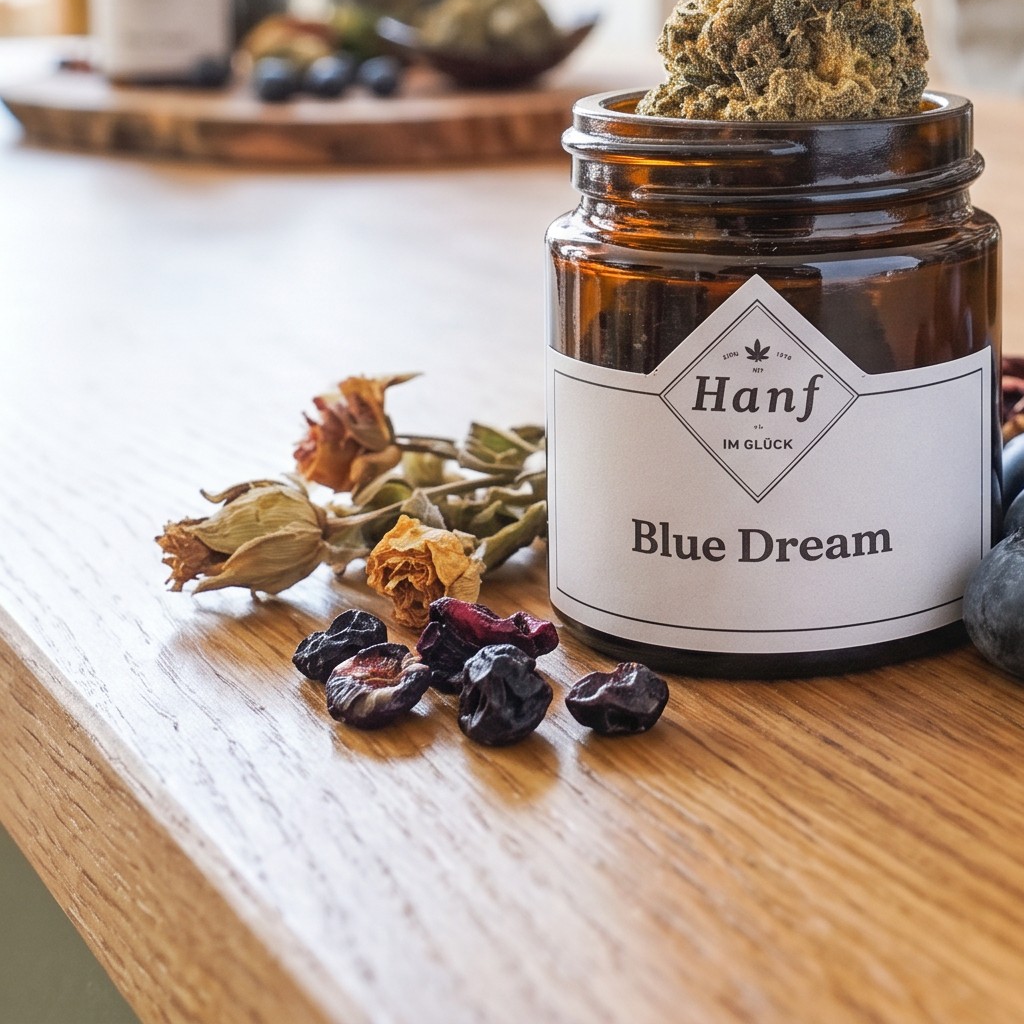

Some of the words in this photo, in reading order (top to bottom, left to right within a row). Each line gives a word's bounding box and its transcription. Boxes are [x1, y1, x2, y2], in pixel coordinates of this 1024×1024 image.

[691, 374, 824, 423] Hanf
[723, 438, 740, 450] IM
[743, 437, 794, 450] GLÜCK
[631, 518, 726, 563] Blue
[738, 528, 893, 563] Dream
